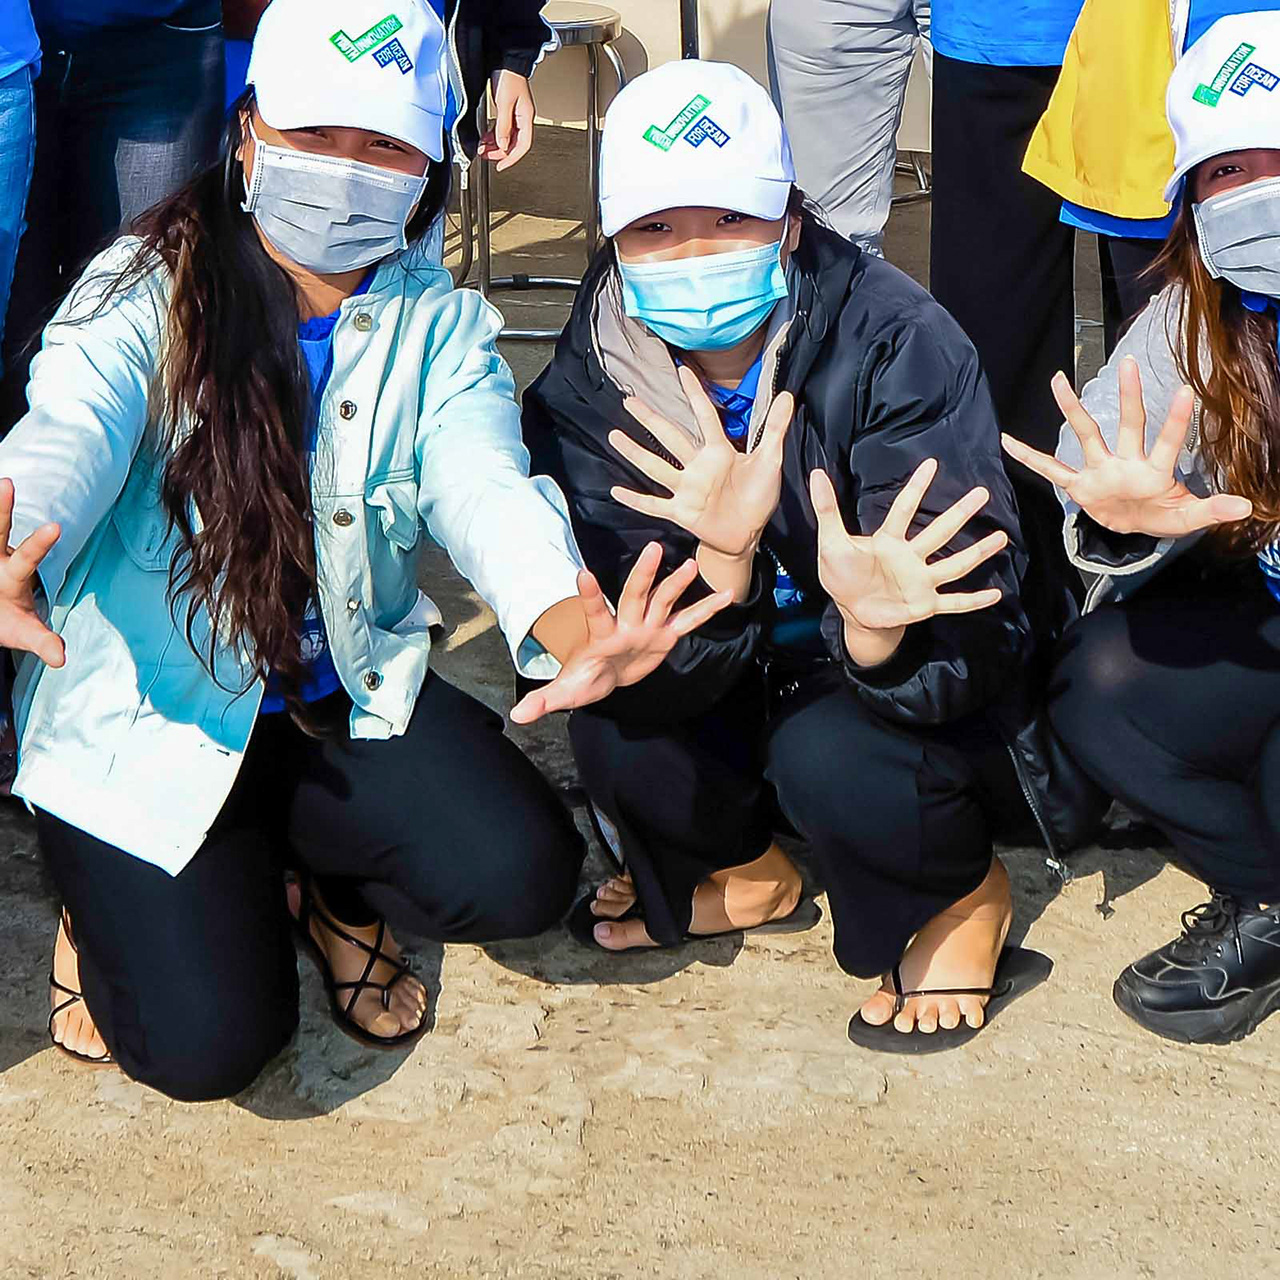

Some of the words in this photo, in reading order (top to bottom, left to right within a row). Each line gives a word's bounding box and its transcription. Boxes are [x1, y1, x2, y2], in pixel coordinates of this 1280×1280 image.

[376, 48, 394, 65] FOR
[390, 42, 411, 72] OCEAN
[1232, 74, 1252, 94] FOR
